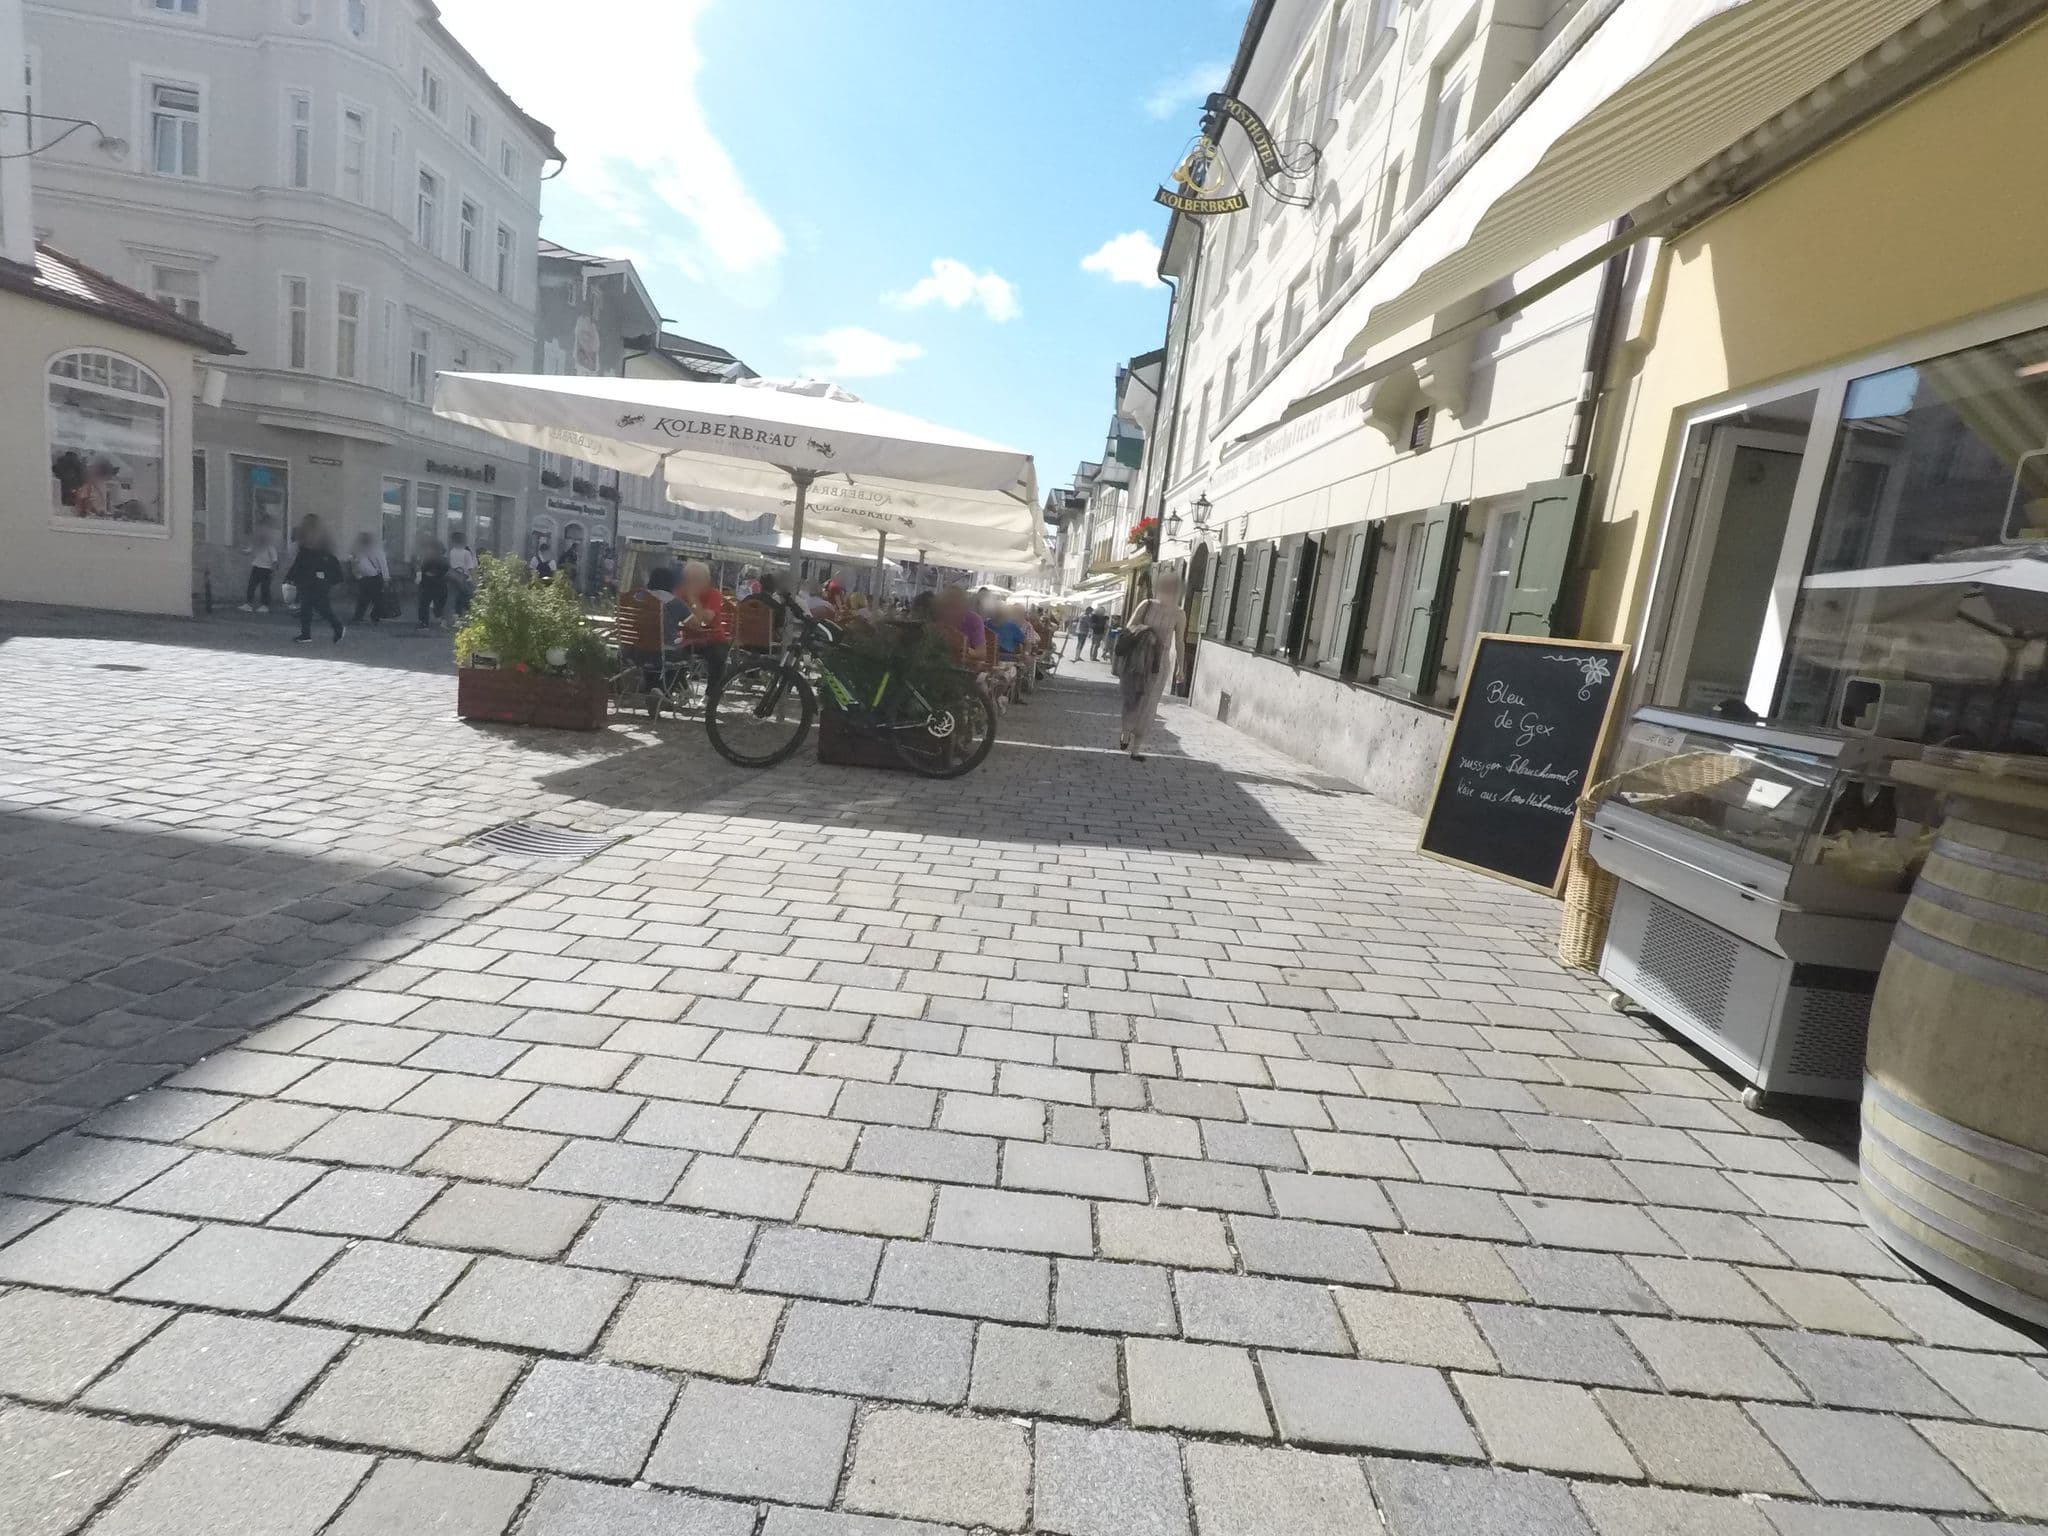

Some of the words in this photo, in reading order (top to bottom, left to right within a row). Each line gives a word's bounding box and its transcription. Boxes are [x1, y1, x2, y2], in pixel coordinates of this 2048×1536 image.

[1223, 99, 1276, 168] POSTHOTEL
[1486, 680, 1525, 706] Bleu
[1494, 709, 1513, 729] de
[1515, 711, 1555, 747] Gex
[1480, 791, 1498, 802] aus
